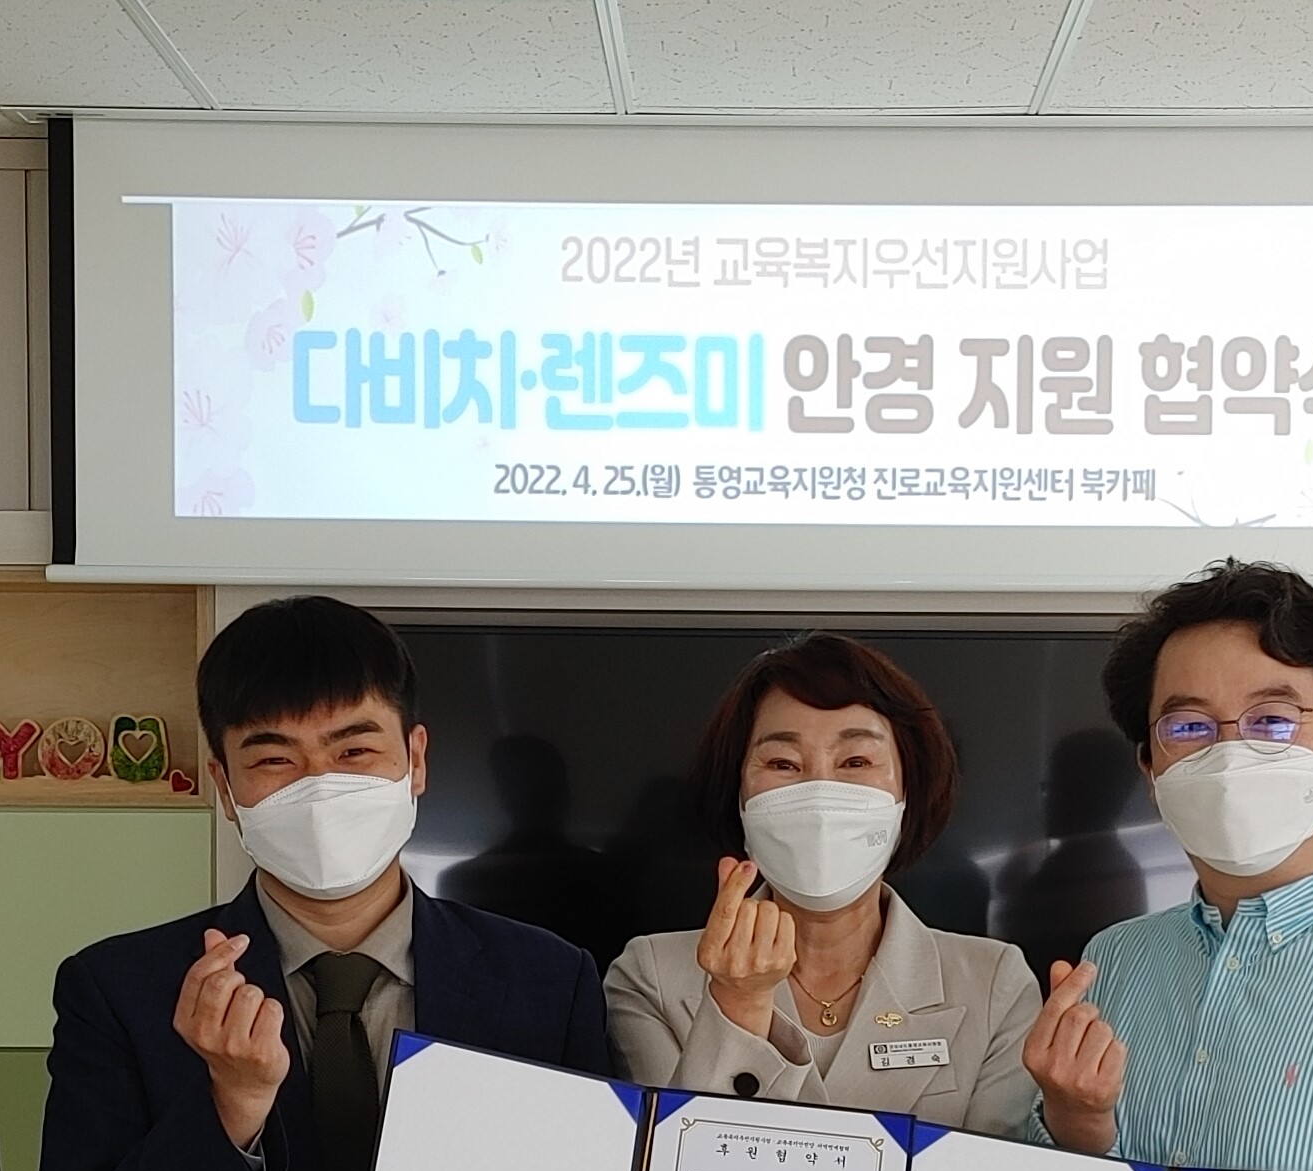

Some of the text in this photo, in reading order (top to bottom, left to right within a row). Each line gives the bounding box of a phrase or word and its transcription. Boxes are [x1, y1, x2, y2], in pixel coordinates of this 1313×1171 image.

[561, 235, 1108, 290] 2022년 교육복지우선지원사업
[292, 327, 765, 433] 다비치·렌즈미
[783, 332, 934, 434] 안경
[958, 333, 1114, 435] 지원
[494, 464, 567, 497] 2022.
[692, 466, 867, 501] 통영교육지원청
[873, 466, 1073, 501] 진로교육지원센터
[1080, 467, 1157, 502] 북카페
